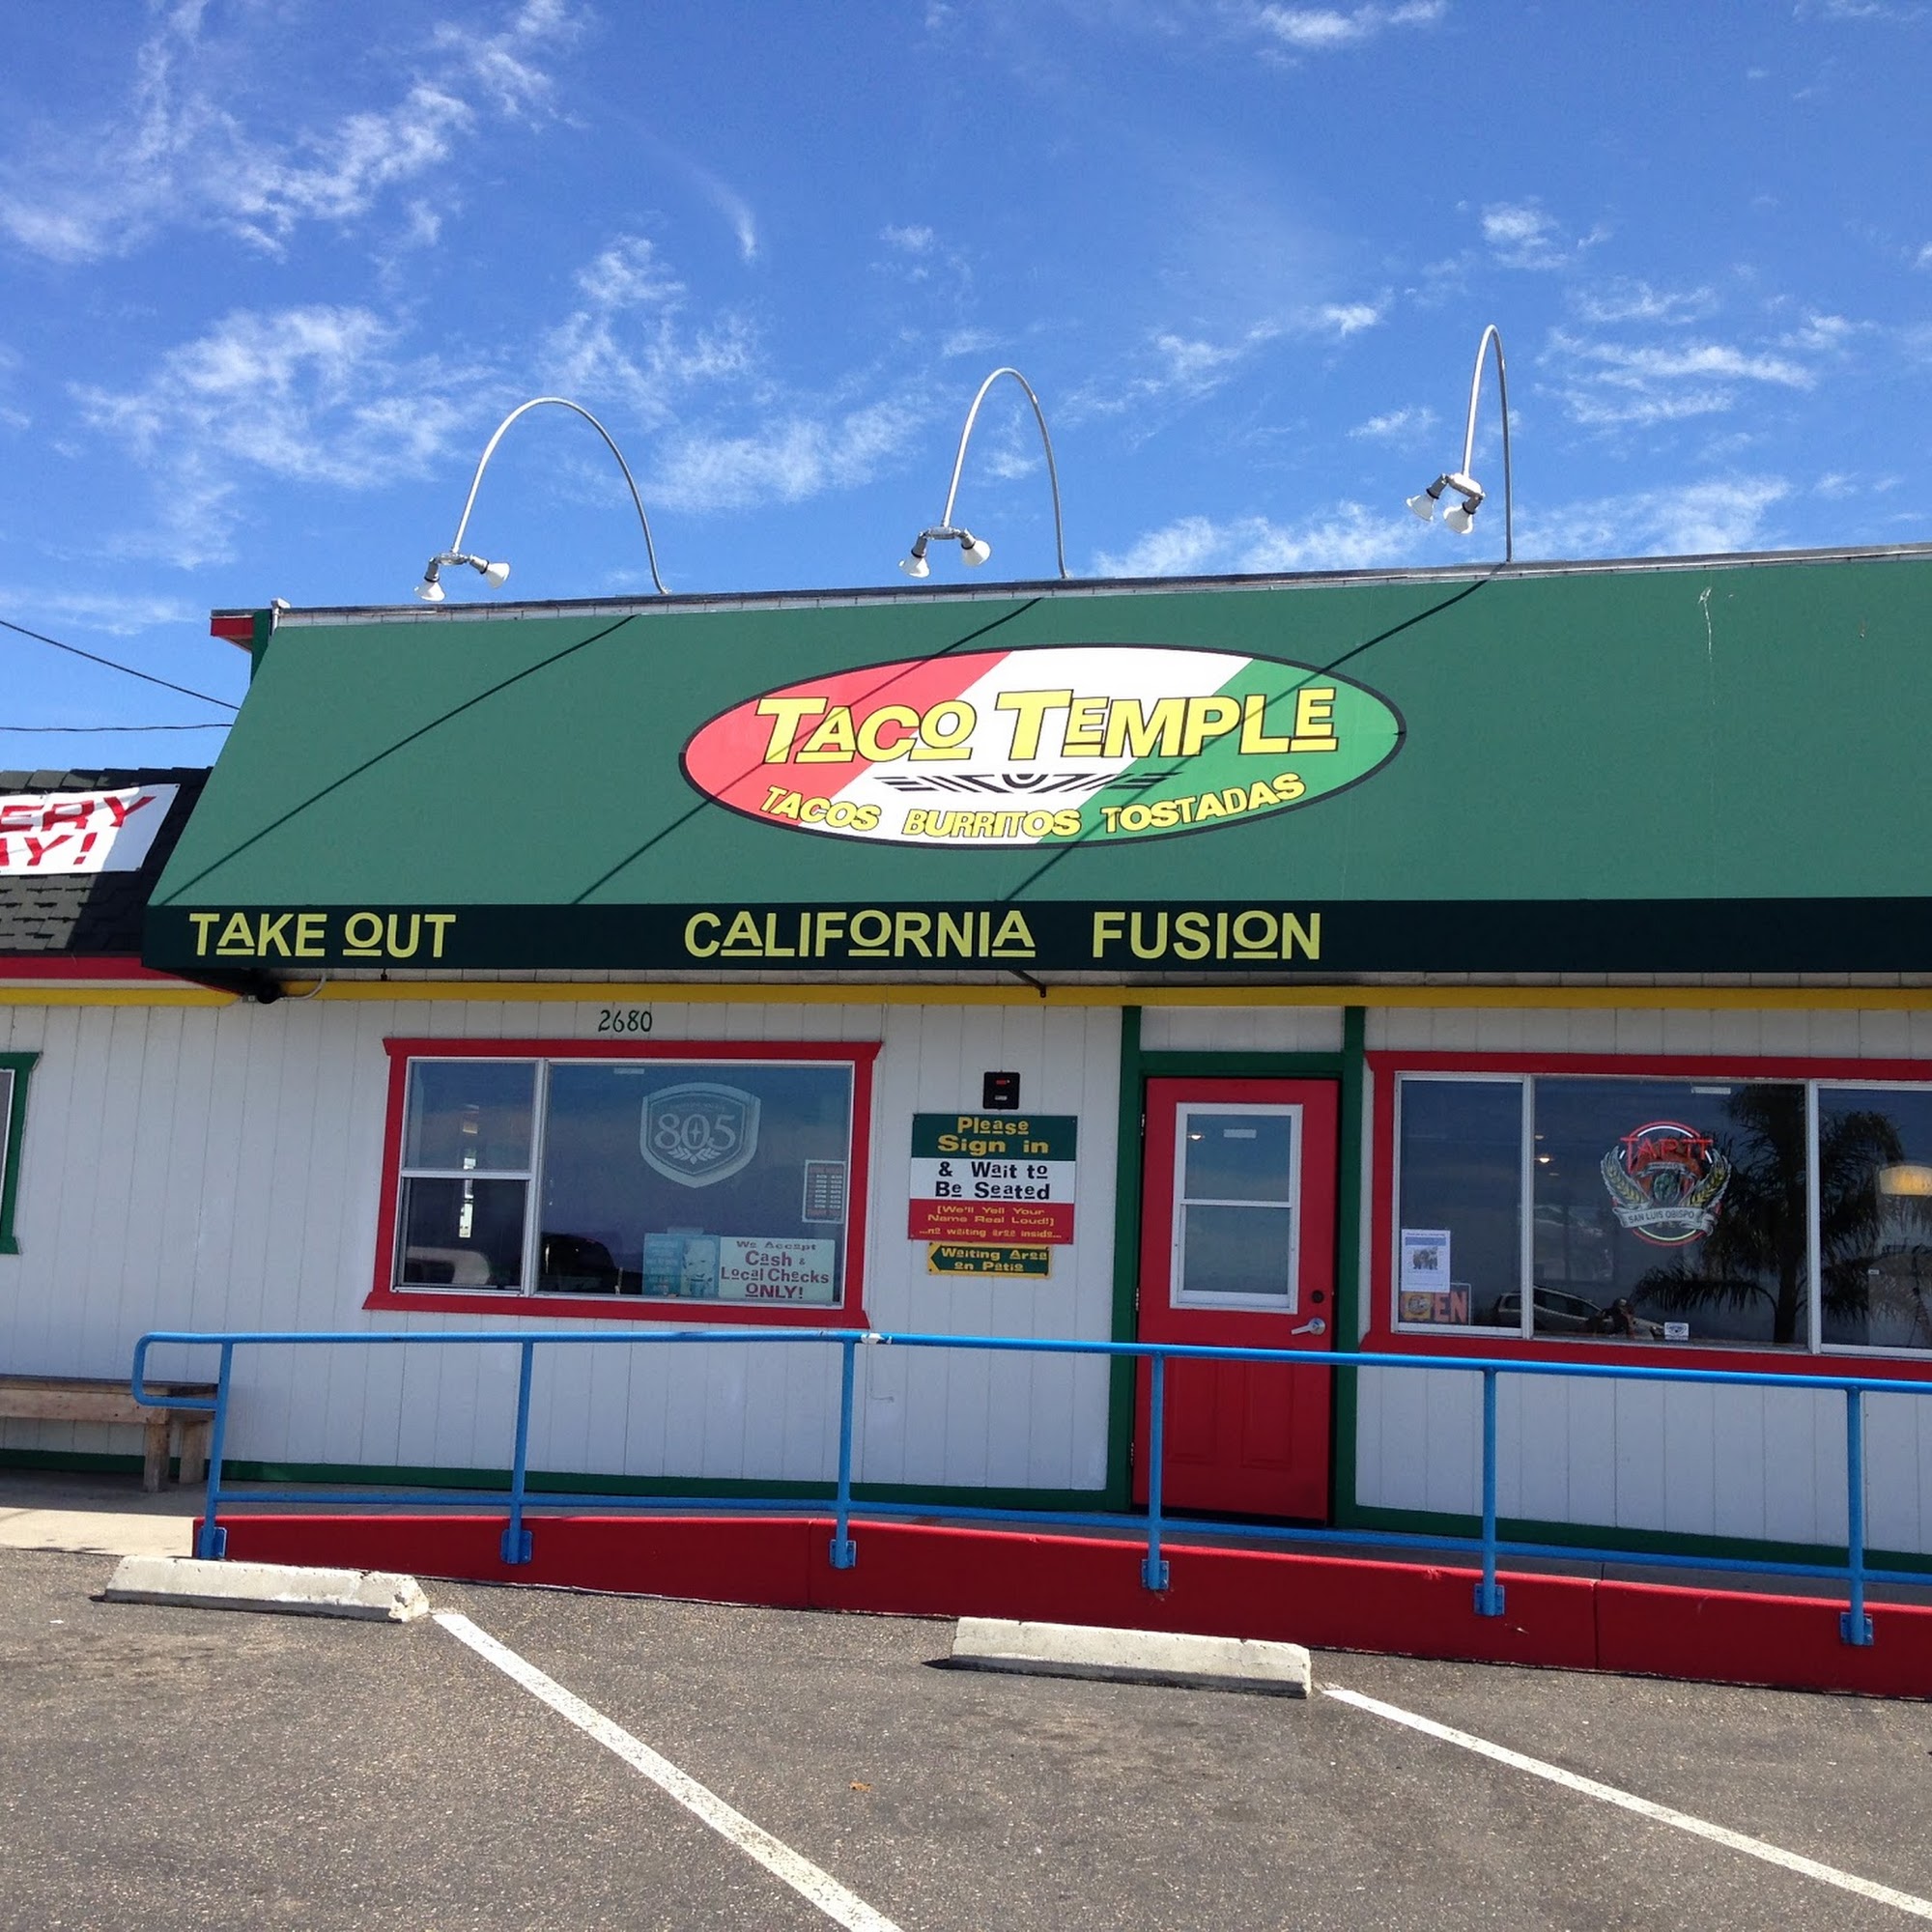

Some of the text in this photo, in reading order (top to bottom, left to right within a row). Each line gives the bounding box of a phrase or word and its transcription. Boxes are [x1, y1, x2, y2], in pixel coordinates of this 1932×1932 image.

[755, 687, 1340, 764] TACO TEMPLE
[760, 772, 1306, 838] TACOS BURRITOS TOSTADAS
[189, 912, 457, 958] TAKE OUT
[684, 910, 1321, 960] CALIFORNIA FUSION
[598, 1009, 653, 1033] 2680
[654, 1113, 736, 1151] 805
[957, 1117, 1030, 1135] Please
[937, 1135, 1049, 1156] Sign in
[938, 1161, 1048, 1179] & Wait to
[935, 1180, 1050, 1200] Be Seated
[927, 1214, 968, 1223] Name
[974, 1215, 1005, 1224] Real
[1012, 1208, 1045, 1216] Your
[1628, 1209, 1694, 1224] SAN LUIS OBISPO
[947, 1228, 986, 1238] waiting
[764, 1241, 817, 1251] Accept
[941, 1247, 1048, 1262] Waiting Area
[745, 1250, 793, 1267] Cash
[953, 1261, 1025, 1272] on Patio
[721, 1266, 830, 1284] Local Checks
[745, 1283, 804, 1299] ONLY!
